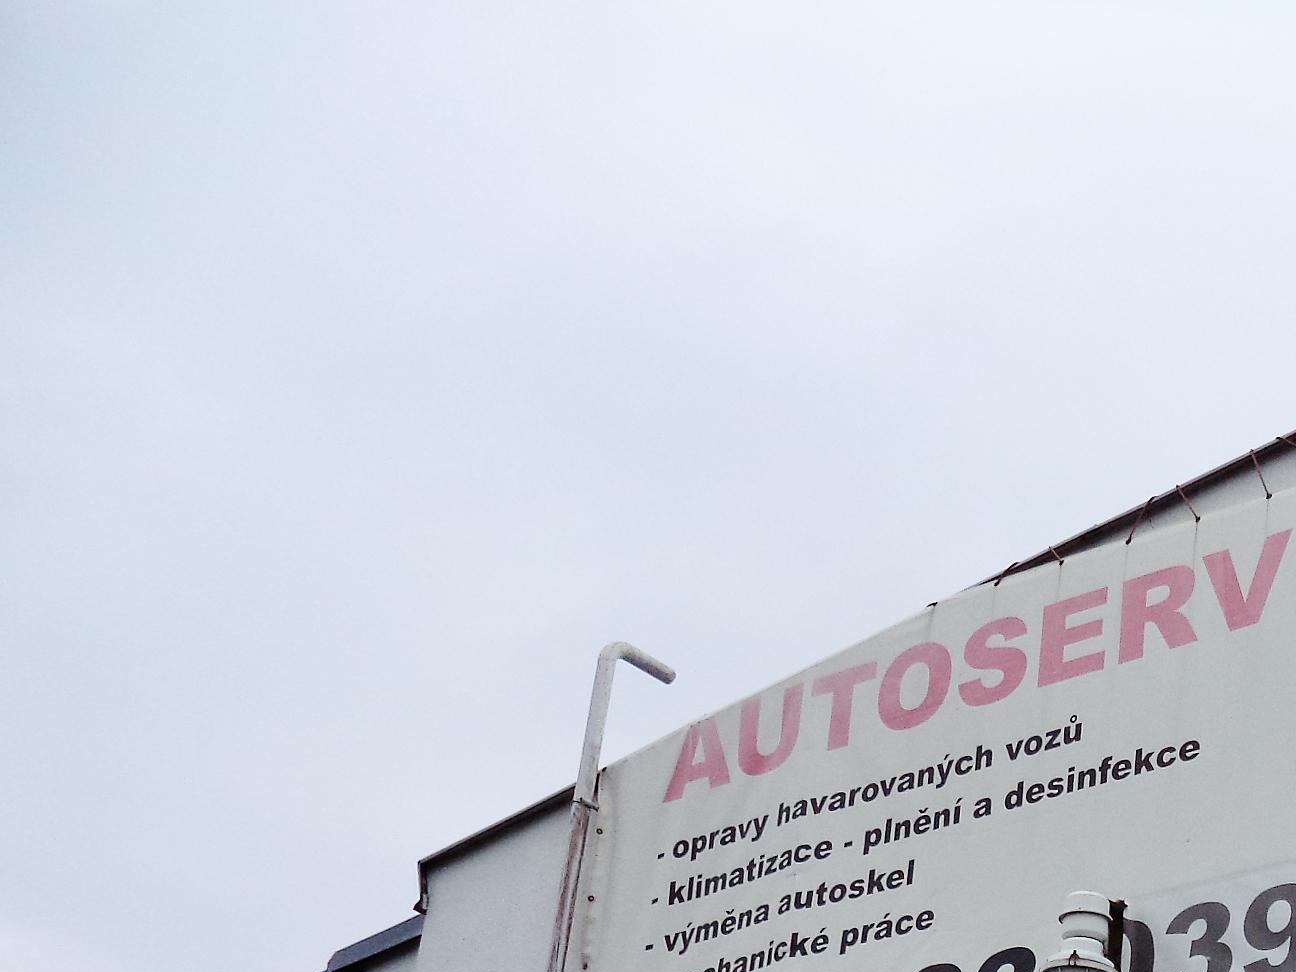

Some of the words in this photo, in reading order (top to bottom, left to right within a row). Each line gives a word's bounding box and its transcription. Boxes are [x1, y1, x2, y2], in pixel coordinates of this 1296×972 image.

[667, 839, 833, 905] klimatizace
[862, 797, 962, 855] plnění
[973, 796, 993, 820] a
[1004, 739, 1201, 812] desinfekce
[672, 814, 769, 861] opravy
[776, 745, 993, 828] havarovaných
[1005, 714, 1084, 762] vozů
[664, 902, 770, 955] výměna
[777, 859, 916, 915] autoskel
[839, 908, 935, 955] práce
